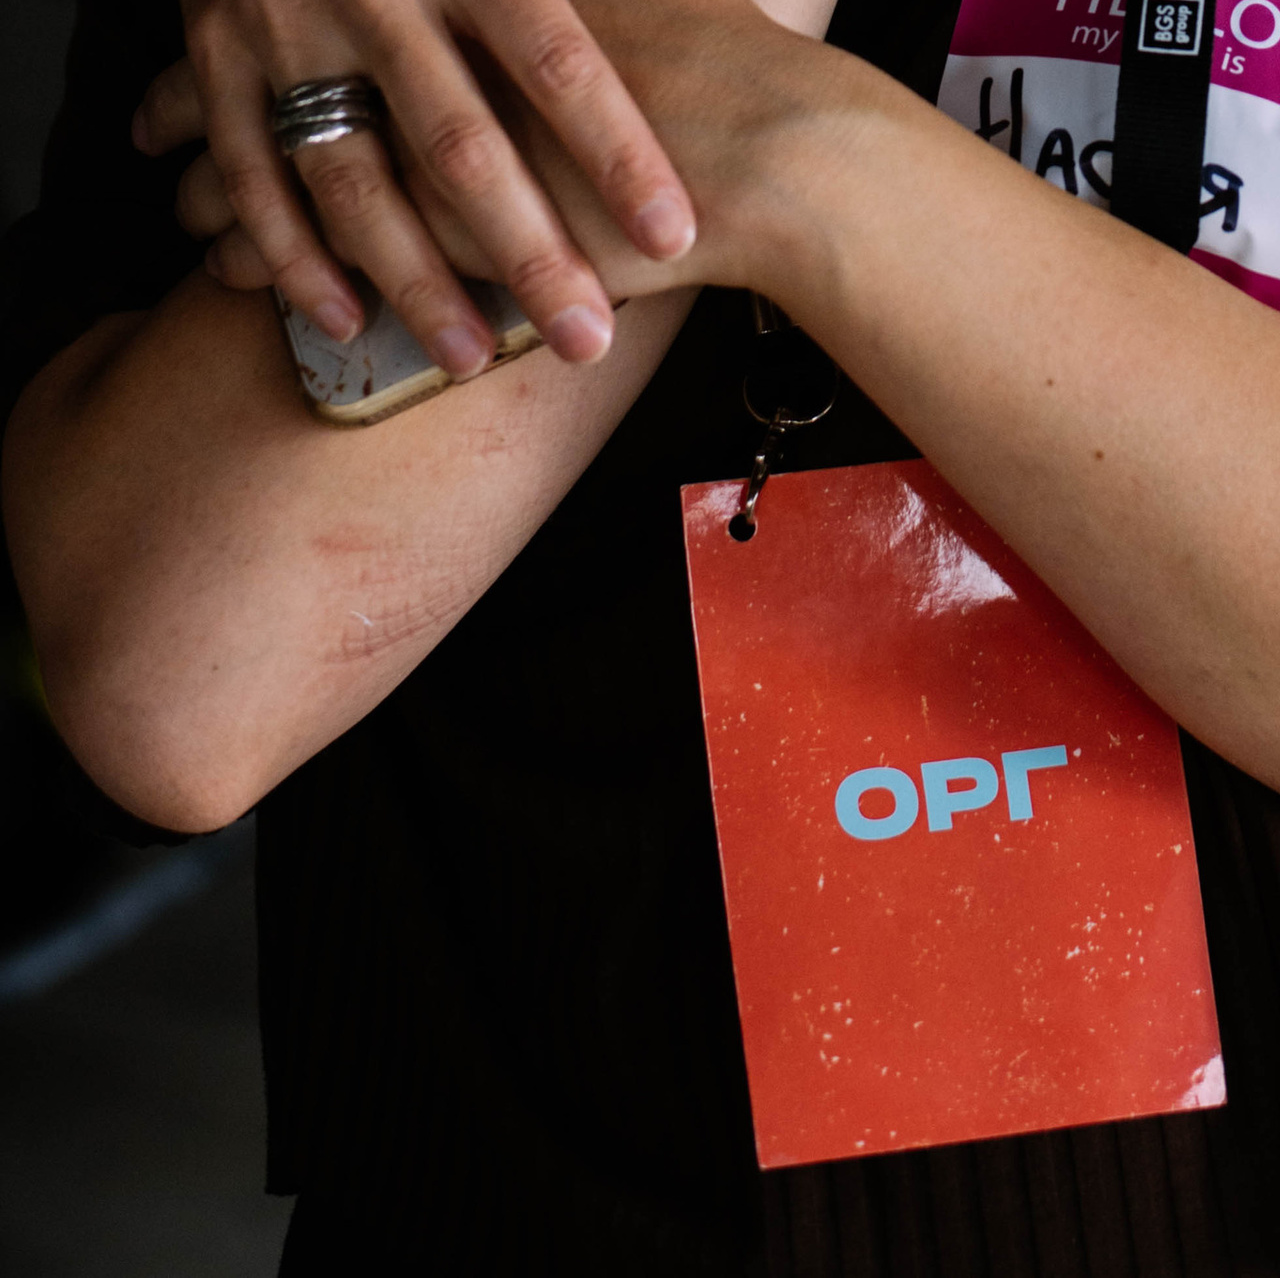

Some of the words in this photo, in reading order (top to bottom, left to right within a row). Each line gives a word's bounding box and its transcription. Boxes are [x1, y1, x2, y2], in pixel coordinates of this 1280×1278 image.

[1071, 22, 1119, 53] my
[1220, 47, 1246, 75] is
[1154, 4, 1175, 42] BGS
[1175, 5, 1193, 44] group
[974, 67, 1244, 233] НАСЯ
[834, 745, 1068, 841] ОРГ
